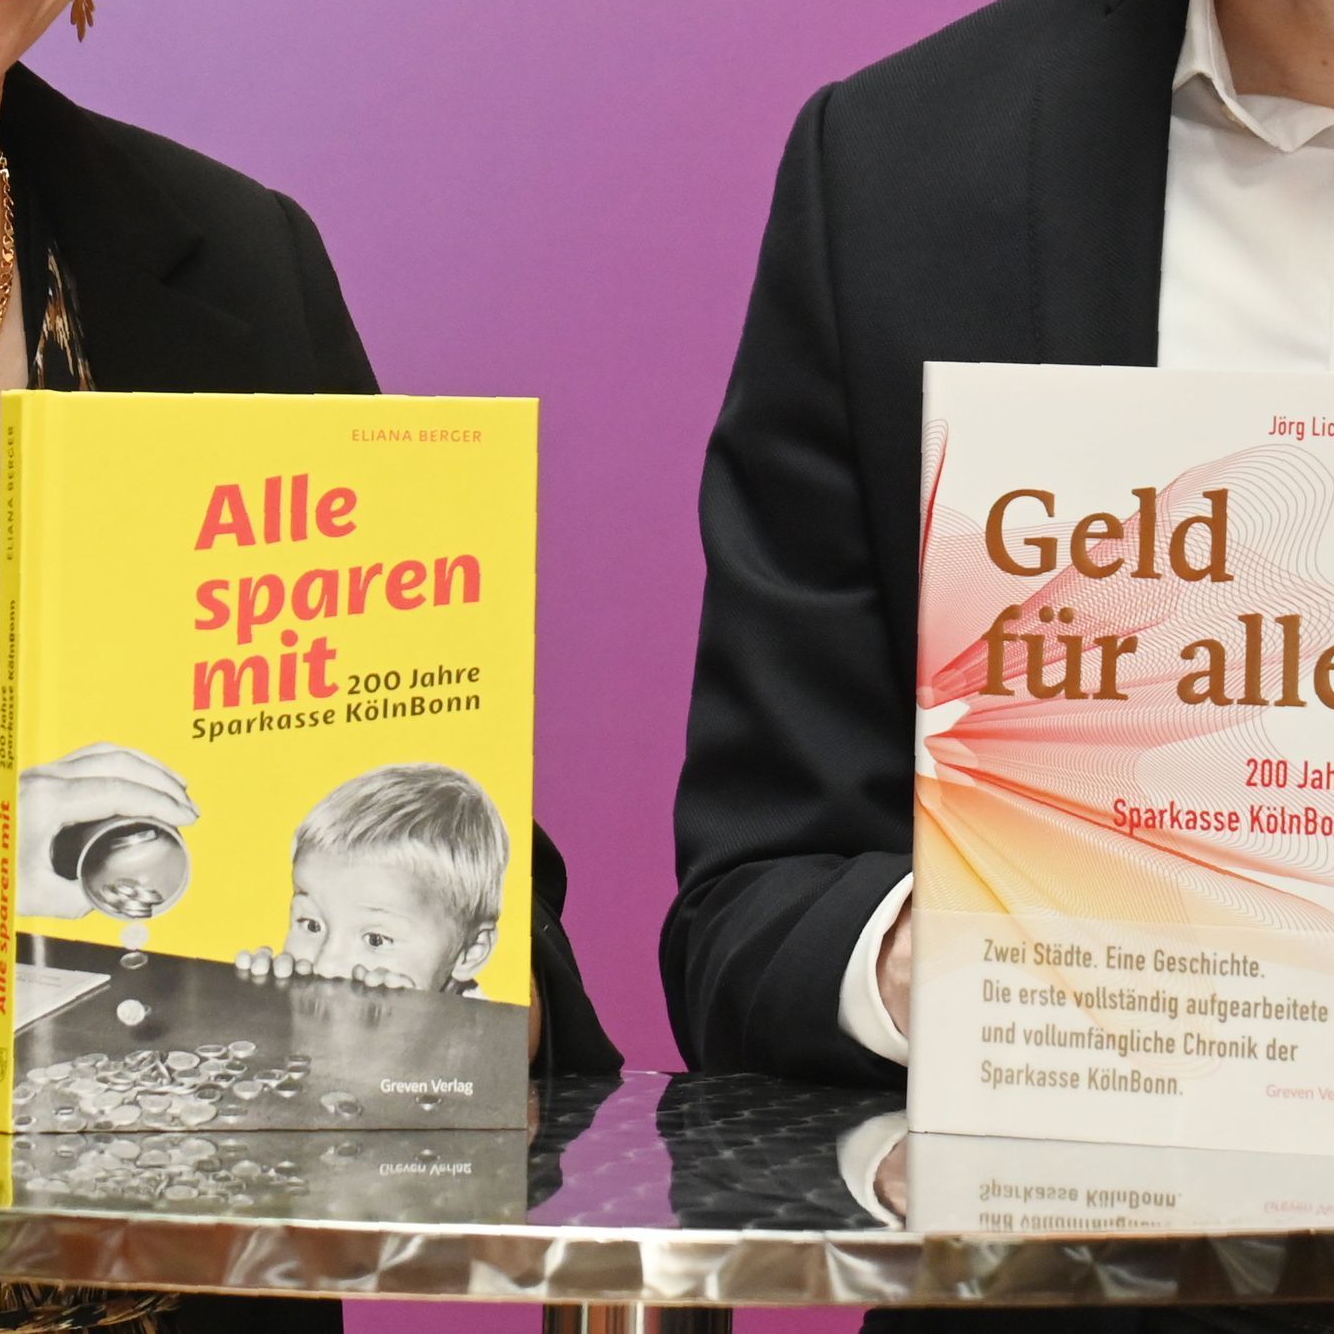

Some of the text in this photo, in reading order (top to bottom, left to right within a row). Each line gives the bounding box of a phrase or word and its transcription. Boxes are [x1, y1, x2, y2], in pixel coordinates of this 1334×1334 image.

[351, 429, 482, 443] ELIANA BERGER
[1268, 414, 1306, 442] Jörg
[193, 473, 358, 551] Alle
[985, 487, 1234, 583] Geld
[193, 552, 482, 645] sparen
[193, 629, 340, 711] mit
[979, 604, 1138, 701] für
[347, 664, 481, 695] 200 Jahre
[192, 693, 481, 743] Sparkasse KölnBonn
[1245, 757, 1289, 789] 200
[0, 800, 11, 849] mit
[1113, 798, 1240, 836] Sparkasse
[983, 939, 1266, 978] Zwei Städte. Eine Geschichte.
[982, 979, 1329, 1023] Die erste vollständig aufgearbeitete
[981, 1022, 1299, 1062] und vollumfängliche Chronik der
[380, 1078, 474, 1096] Greven Verlag
[981, 1060, 1183, 1096] Sparkasse KölnBonn.
[1265, 1083, 1314, 1100] Greven
